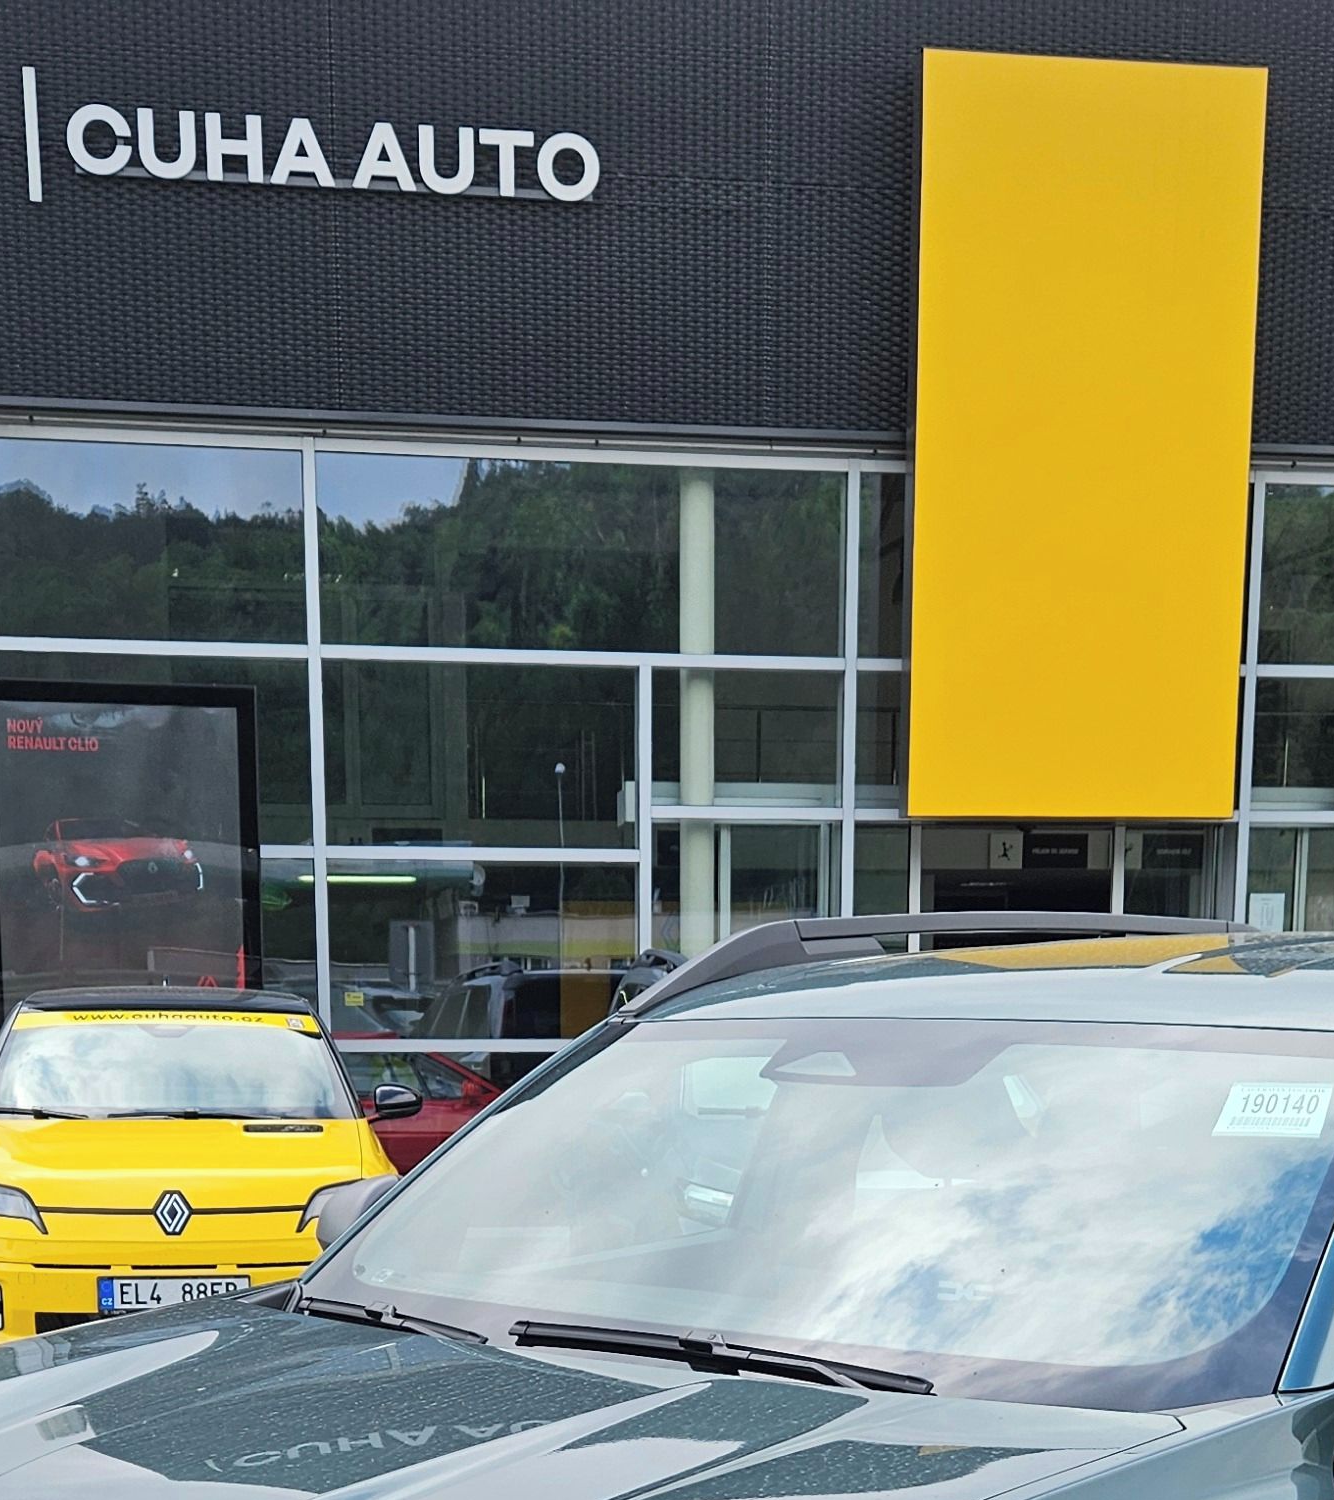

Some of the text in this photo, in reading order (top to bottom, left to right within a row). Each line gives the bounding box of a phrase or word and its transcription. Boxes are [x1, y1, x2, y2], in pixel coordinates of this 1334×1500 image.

[67, 102, 601, 201] CUHA AUTO
[6, 715, 44, 734] NOVÝ
[7, 735, 100, 752] RENAULT CLIO
[1240, 1093, 1320, 1114] 190140
[101, 1298, 114, 1306] CZ
[119, 1282, 162, 1305] EL4
